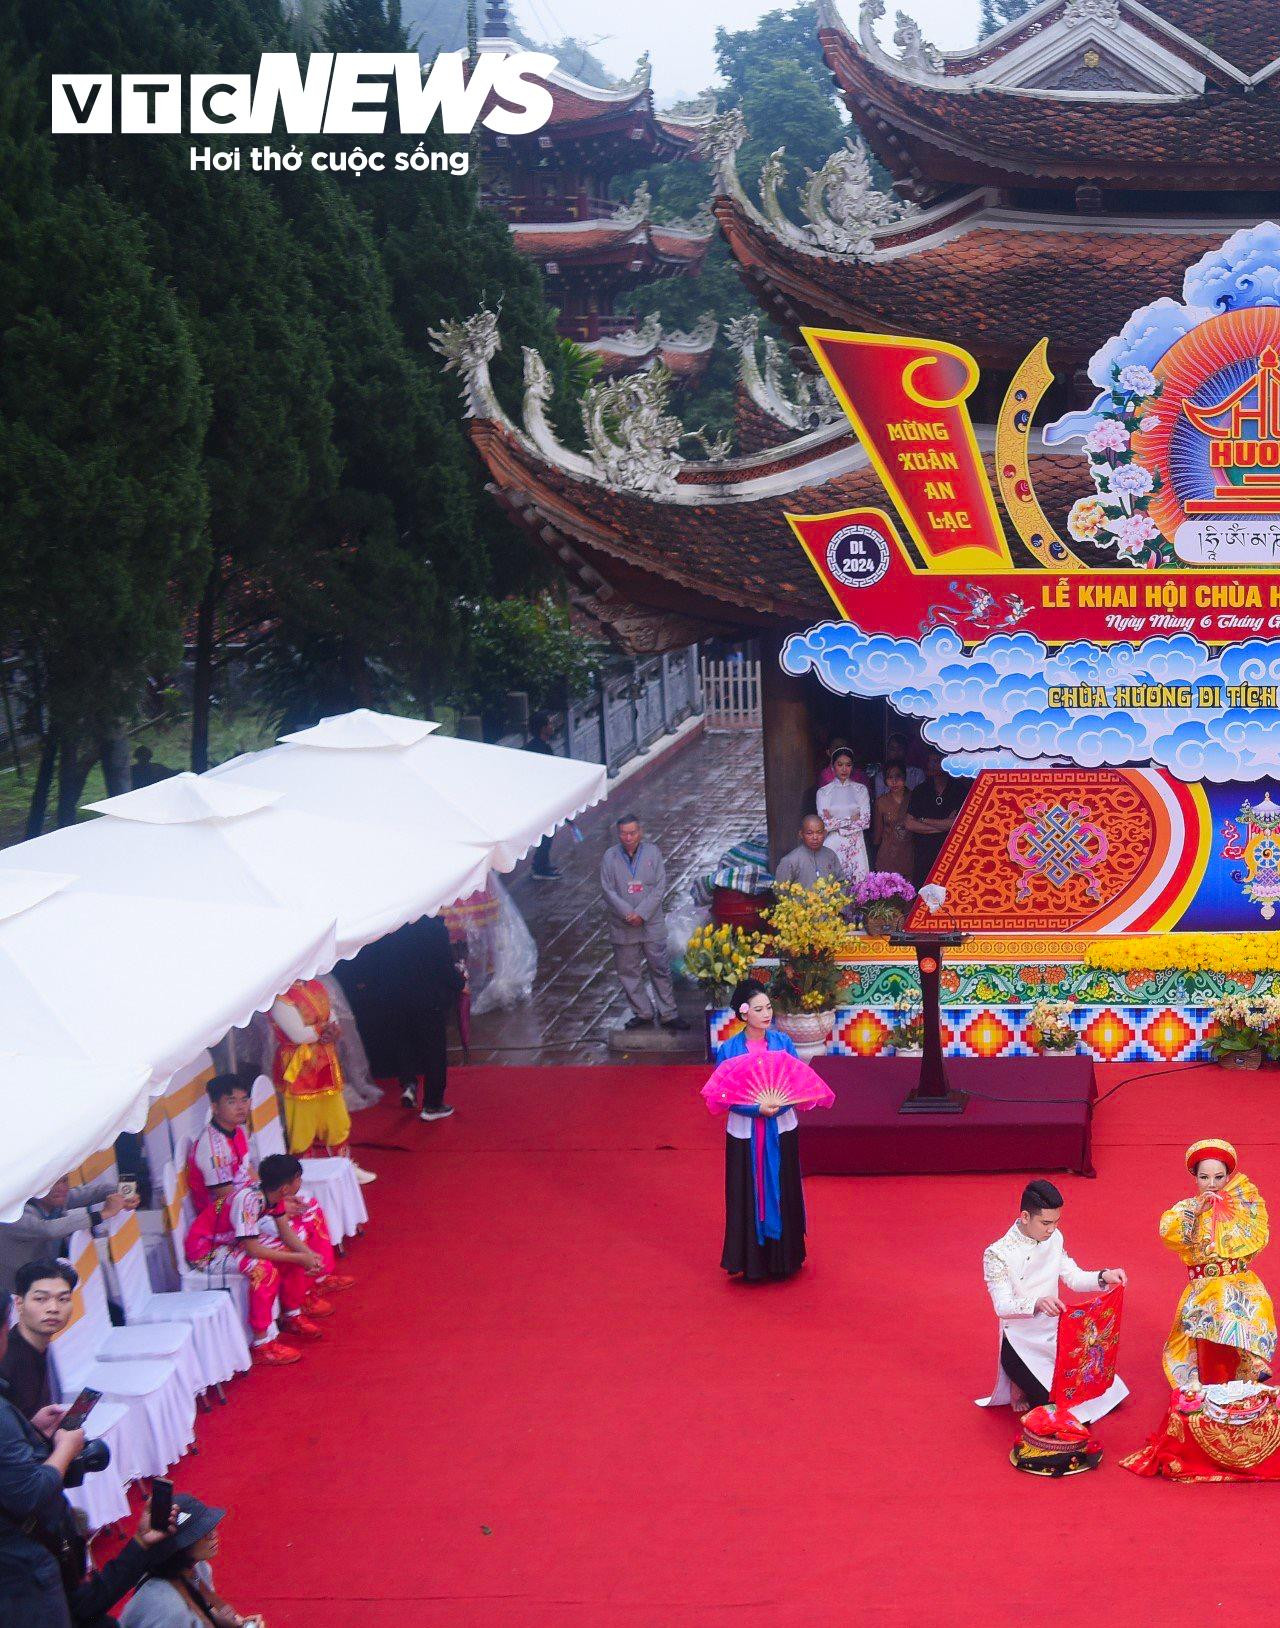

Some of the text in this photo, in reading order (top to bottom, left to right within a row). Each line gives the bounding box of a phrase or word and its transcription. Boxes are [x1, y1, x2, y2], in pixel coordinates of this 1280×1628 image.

[886, 419, 950, 442] MỪNG
[898, 448, 960, 471] XUÂN
[924, 481, 956, 500] AN
[927, 511, 972, 533] LẠC
[849, 540, 867, 555] DL
[842, 558, 875, 573] 2024
[1042, 577, 1071, 608] LỄ
[1078, 585, 1137, 608] KHAI
[1145, 580, 1187, 613] HỘI
[1195, 580, 1263, 608] CHÙA
[1105, 614, 1146, 631] Ngày
[1199, 615, 1213, 629] 6
[1217, 614, 1265, 631] Tháng
[1047, 681, 1111, 709] CHÙA
[1114, 682, 1194, 709] HƯƠNG
[1196, 685, 1224, 709] DI
[1226, 681, 1279, 709] TÍCH
